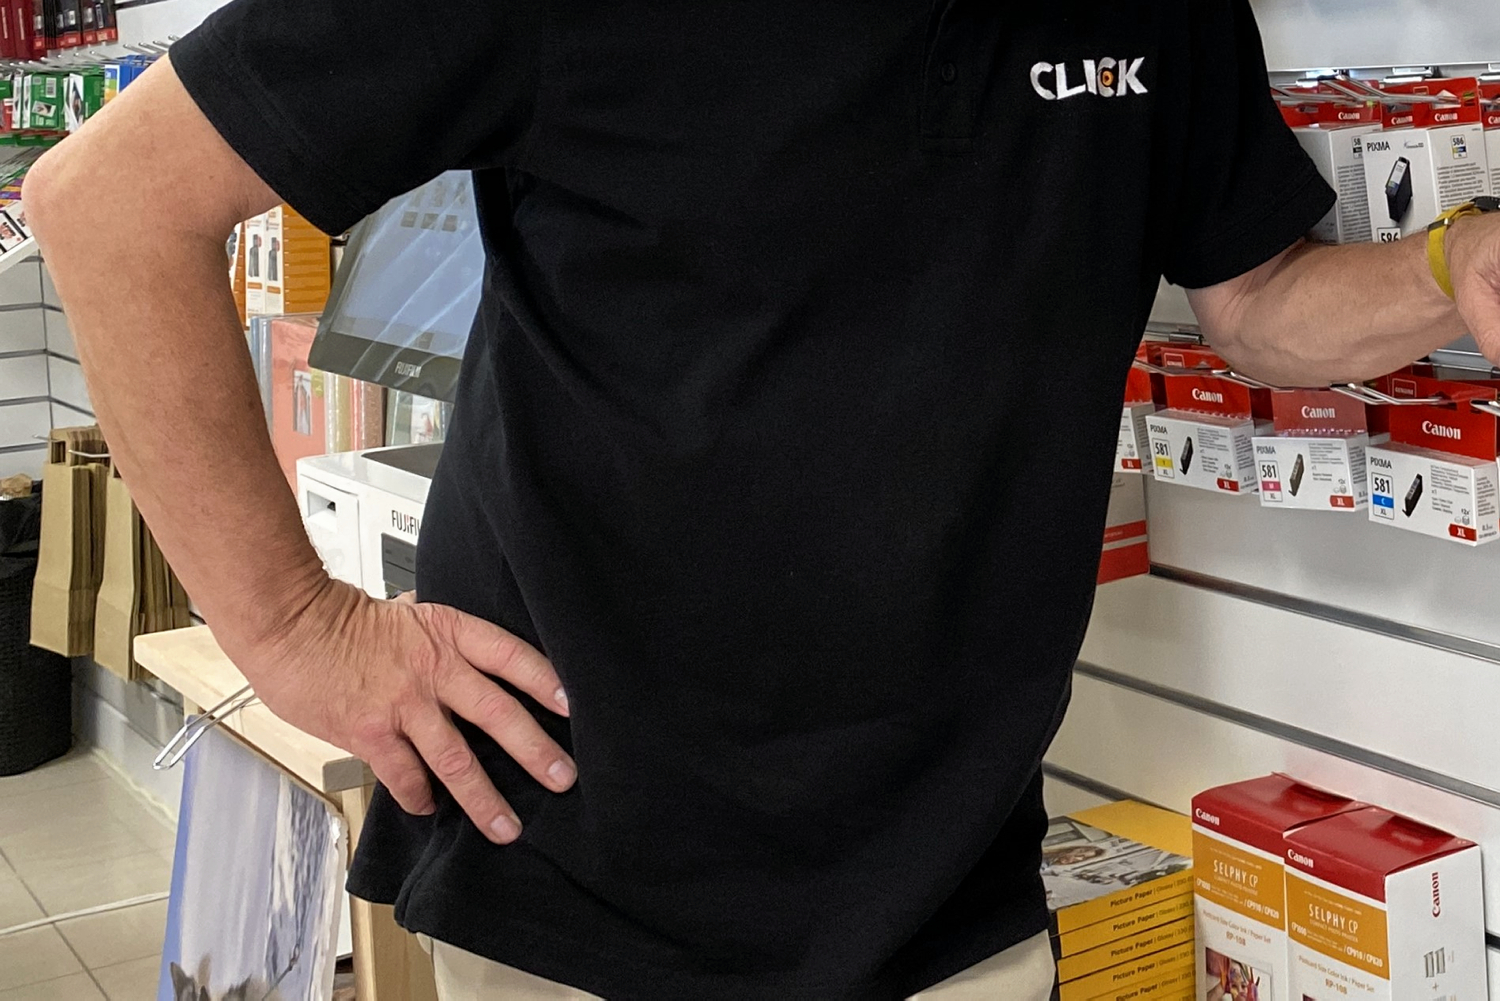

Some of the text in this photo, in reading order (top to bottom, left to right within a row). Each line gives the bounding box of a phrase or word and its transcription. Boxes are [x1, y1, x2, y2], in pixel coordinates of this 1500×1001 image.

[1030, 56, 1148, 100] CLICK
[1338, 112, 1360, 121] Canon
[1391, 116, 1413, 126] Canon
[1434, 112, 1458, 122] Canon
[1353, 138, 1362, 146] 58
[1366, 141, 1390, 152] PIXMA
[1452, 137, 1465, 146] 586
[1380, 231, 1400, 243] 586
[1192, 388, 1224, 403] Canon
[1301, 406, 1336, 418] Canon
[1150, 424, 1168, 434] PIXMA
[1422, 420, 1462, 440] Canon
[1155, 442, 1169, 456] 581
[1256, 446, 1276, 454] PIXMA
[1370, 456, 1392, 469] PIXMA
[1262, 464, 1276, 478] 581
[1374, 477, 1390, 494] 581
[1380, 508, 1387, 516] XL
[392, 510, 420, 536] FUJIFI
[1457, 526, 1466, 537] XL
[1196, 808, 1220, 826] Canon
[1288, 849, 1314, 868] Canon
[1214, 860, 1258, 888] SELPHY CP
[1110, 896, 1132, 908] Picture
[1135, 889, 1152, 900] Paper
[1432, 872, 1441, 918] Canon
[1113, 920, 1136, 931] Picture
[1138, 912, 1156, 923] Paper
[1308, 904, 1358, 934] SELPHY CP
[1111, 946, 1133, 957] Picture
[1136, 938, 1154, 949] Paper
[1113, 970, 1136, 982] Picture
[1138, 962, 1156, 973] Paper
[1140, 984, 1158, 995] Paper
[1326, 978, 1348, 995] RP-108
